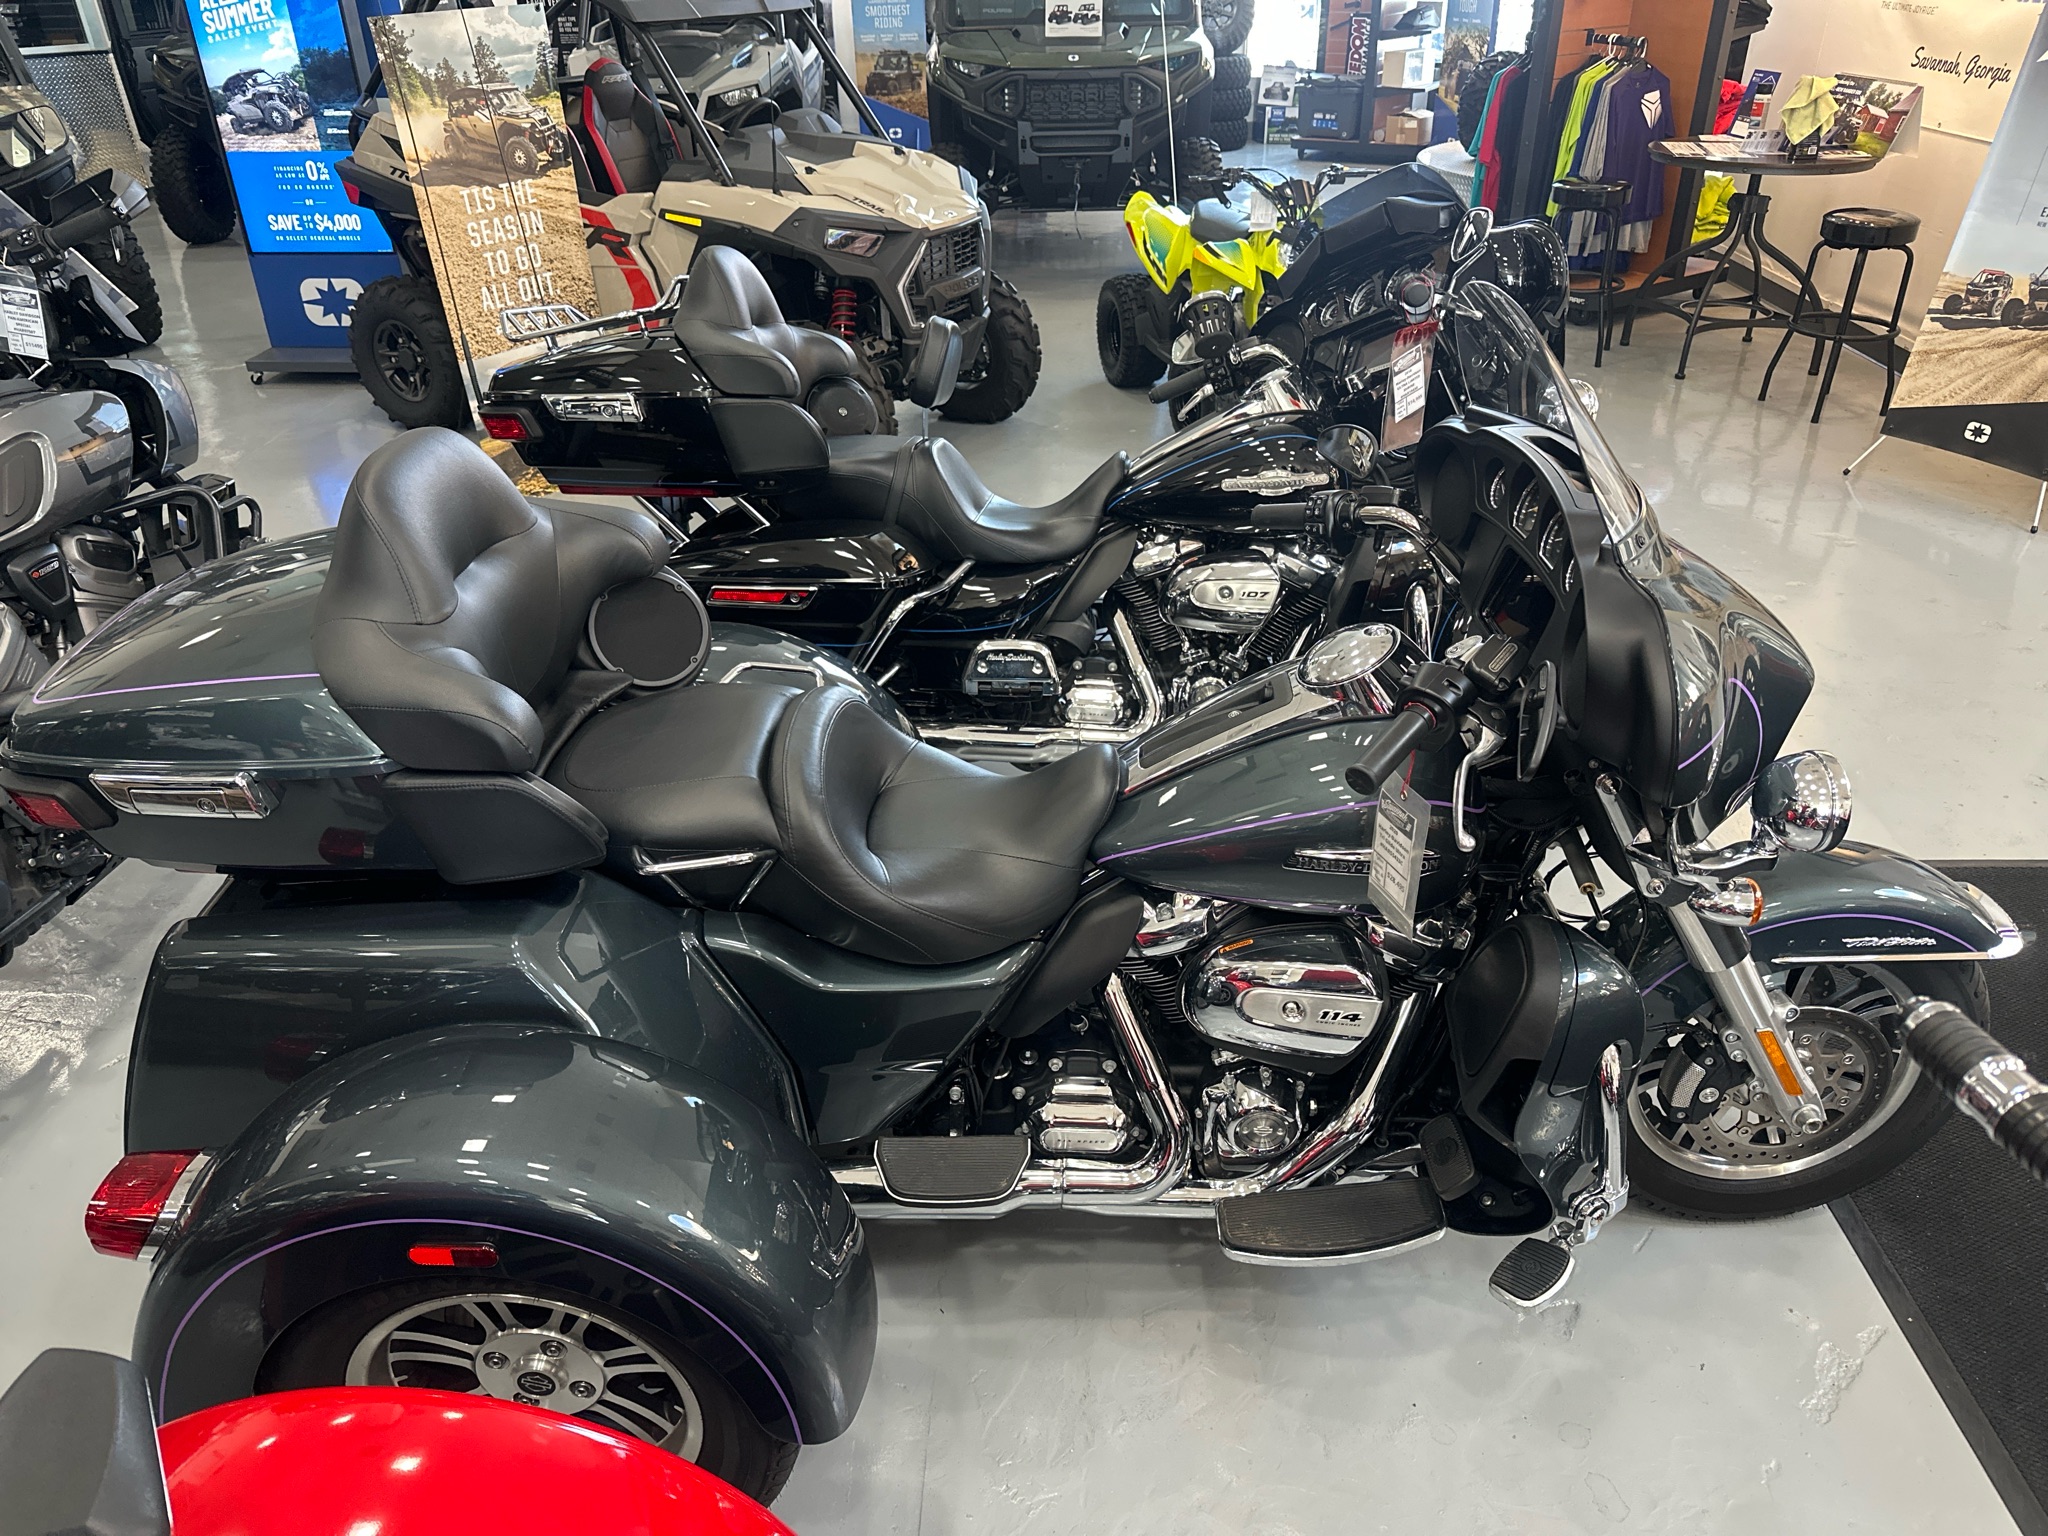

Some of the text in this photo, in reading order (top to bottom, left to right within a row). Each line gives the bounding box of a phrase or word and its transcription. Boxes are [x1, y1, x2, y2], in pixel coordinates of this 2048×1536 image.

[202, 0, 276, 34] SUMMER
[865, 4, 910, 17] SMOOTHEST
[208, 20, 279, 44] SALES EVENT
[874, 17, 903, 29] RIDING
[1910, 46, 2012, 89] Savannah, Georgia
[460, 178, 538, 215] TIS THE
[852, 196, 885, 214] TRAIL
[267, 214, 303, 231] SAVE
[313, 212, 362, 232] $4,000
[467, 209, 545, 248] SEASON
[482, 243, 542, 279] TO GO
[480, 271, 561, 312] ALL OUT.
[1297, 857, 1439, 874] HARLEY-DON
[1227, 939, 1252, 951] WARNING
[1319, 1010, 1365, 1024] 114
